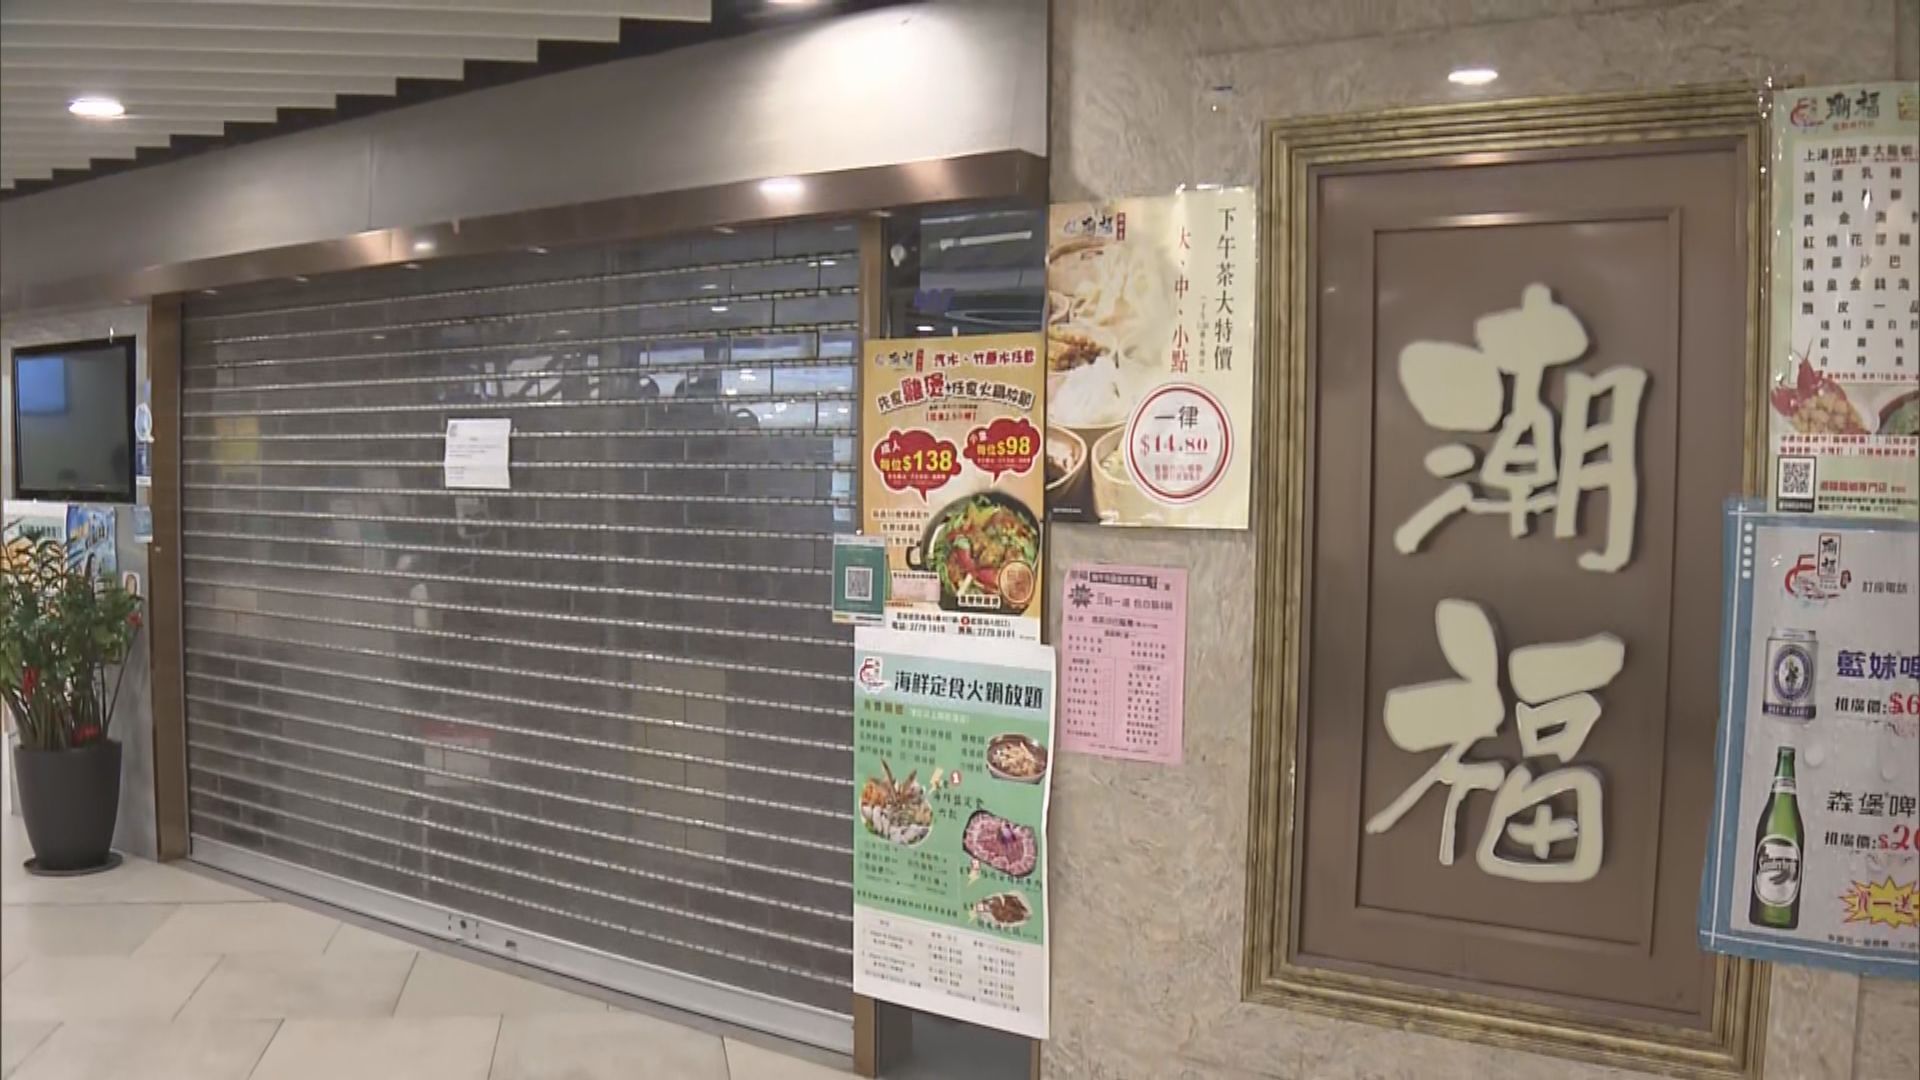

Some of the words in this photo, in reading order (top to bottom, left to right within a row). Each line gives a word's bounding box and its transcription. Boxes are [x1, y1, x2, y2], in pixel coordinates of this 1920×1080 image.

[1213, 207, 1237, 371] 下午茶大特價
[1154, 406, 1199, 428] 一律
[1140, 433, 1208, 457] $14.80
[879, 450, 952, 472] 每位$138
[1366, 283, 1648, 882] 潮福
[894, 670, 1044, 710] 海鮮定食火鍋放題
[1826, 791, 1917, 818] 森堡啤
